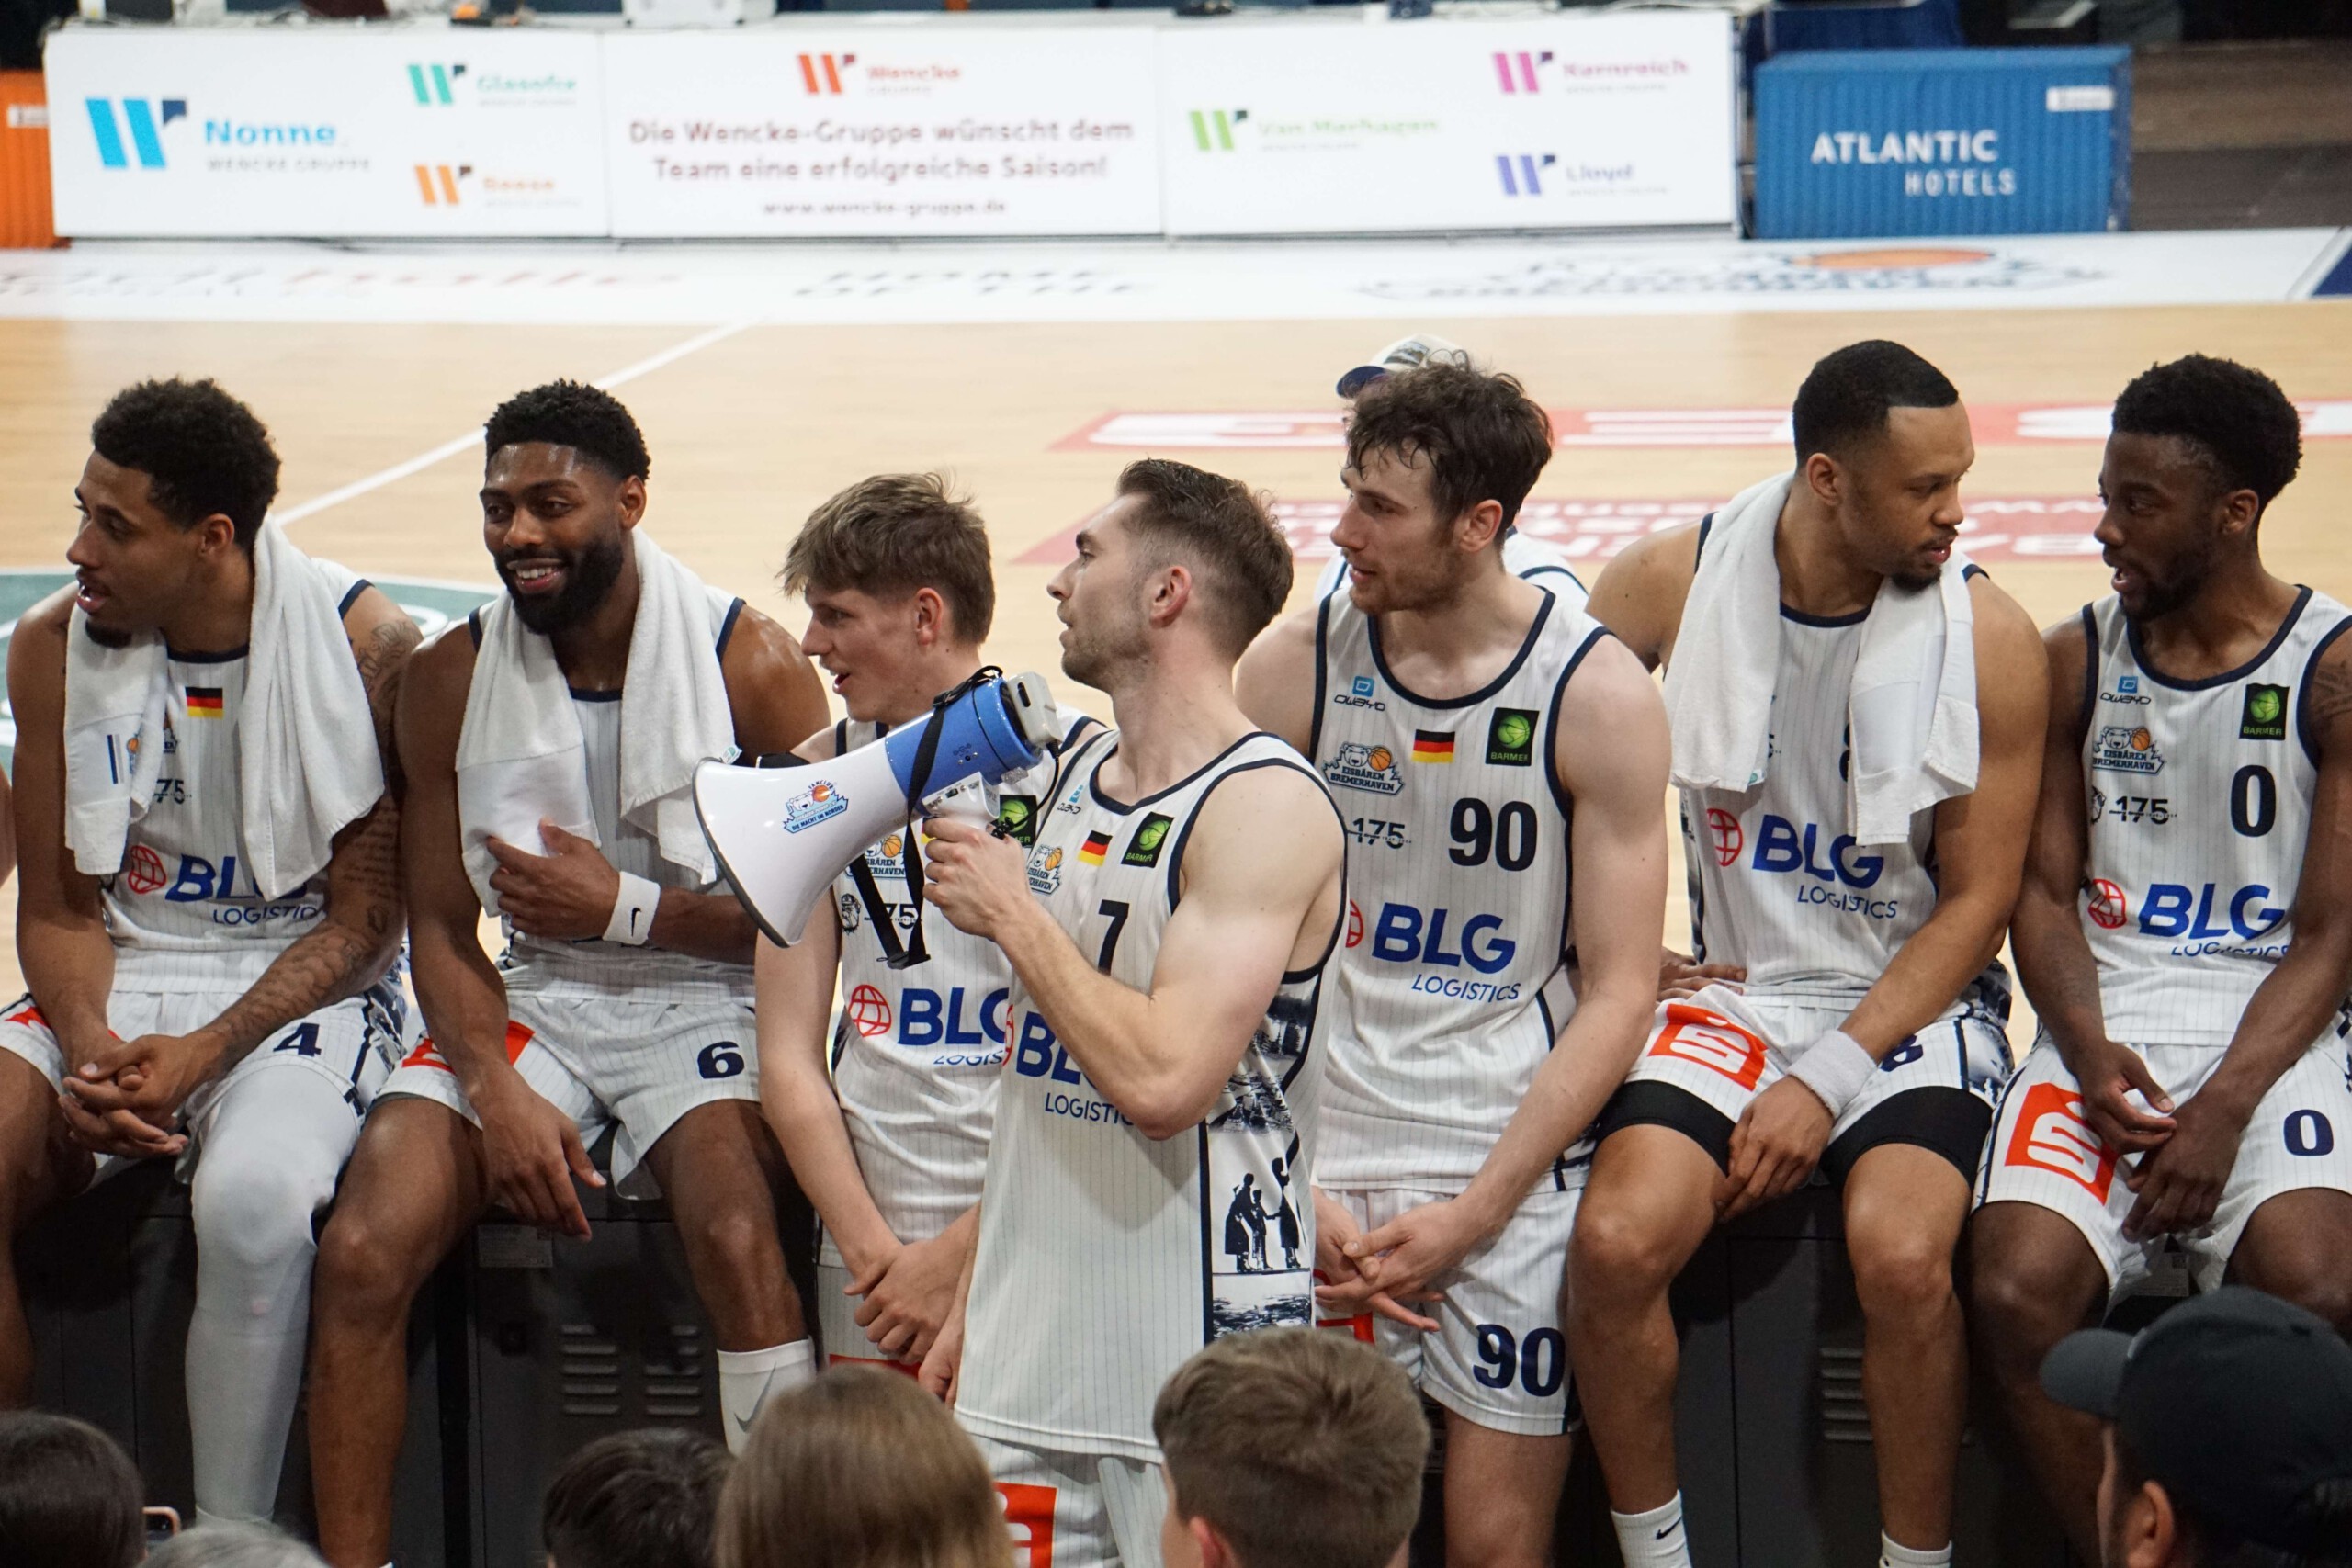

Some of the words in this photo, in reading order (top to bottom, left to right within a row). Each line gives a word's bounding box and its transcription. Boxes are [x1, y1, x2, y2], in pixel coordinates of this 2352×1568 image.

[204, 120, 336, 145] Nonne
[629, 121, 674, 143] Die
[684, 120, 922, 147] Wencke-Gruppe
[933, 118, 1058, 141] wünscht
[1070, 119, 1134, 141] dem
[1811, 130, 1999, 164] ATLANTIC
[653, 157, 731, 181] Team
[741, 158, 798, 180] eine
[810, 155, 989, 184] erfolgreiche
[1905, 168, 2017, 197] HOTELS
[1334, 694, 1386, 713] owayo
[2243, 725, 2283, 736] BARMER
[1330, 773, 1395, 792] BREMERHAVEN
[1341, 766, 1385, 781] EISBÄREN
[156, 778, 185, 806] 75
[2231, 764, 2277, 838] 0
[791, 823, 800, 831] DIE
[800, 816, 818, 827] MACHT
[824, 804, 844, 818] NORDEN
[2115, 795, 2169, 825] 175
[1352, 818, 1406, 850] 175
[1448, 797, 1538, 872] 90
[865, 857, 896, 867] SBÄREN
[1752, 814, 1884, 890] BLG
[870, 867, 905, 876] ERHAVEN
[1029, 876, 1053, 891] ERHAVEN
[883, 903, 919, 930] 75
[1797, 885, 1899, 919] LOGISTICS
[2139, 883, 2286, 941] BLG
[1098, 899, 1130, 974] 7
[1372, 902, 1516, 974] BLG
[1411, 974, 1521, 1003] LOGISTICS
[274, 1022, 322, 1057] 4
[1016, 1012, 1098, 1089] BL
[697, 1041, 745, 1079] 6
[933, 1050, 1003, 1066] LOGIS
[1045, 1092, 1135, 1126] LOGISTI
[2283, 1109, 2334, 1156] 0
[1473, 1324, 1566, 1397] 90
